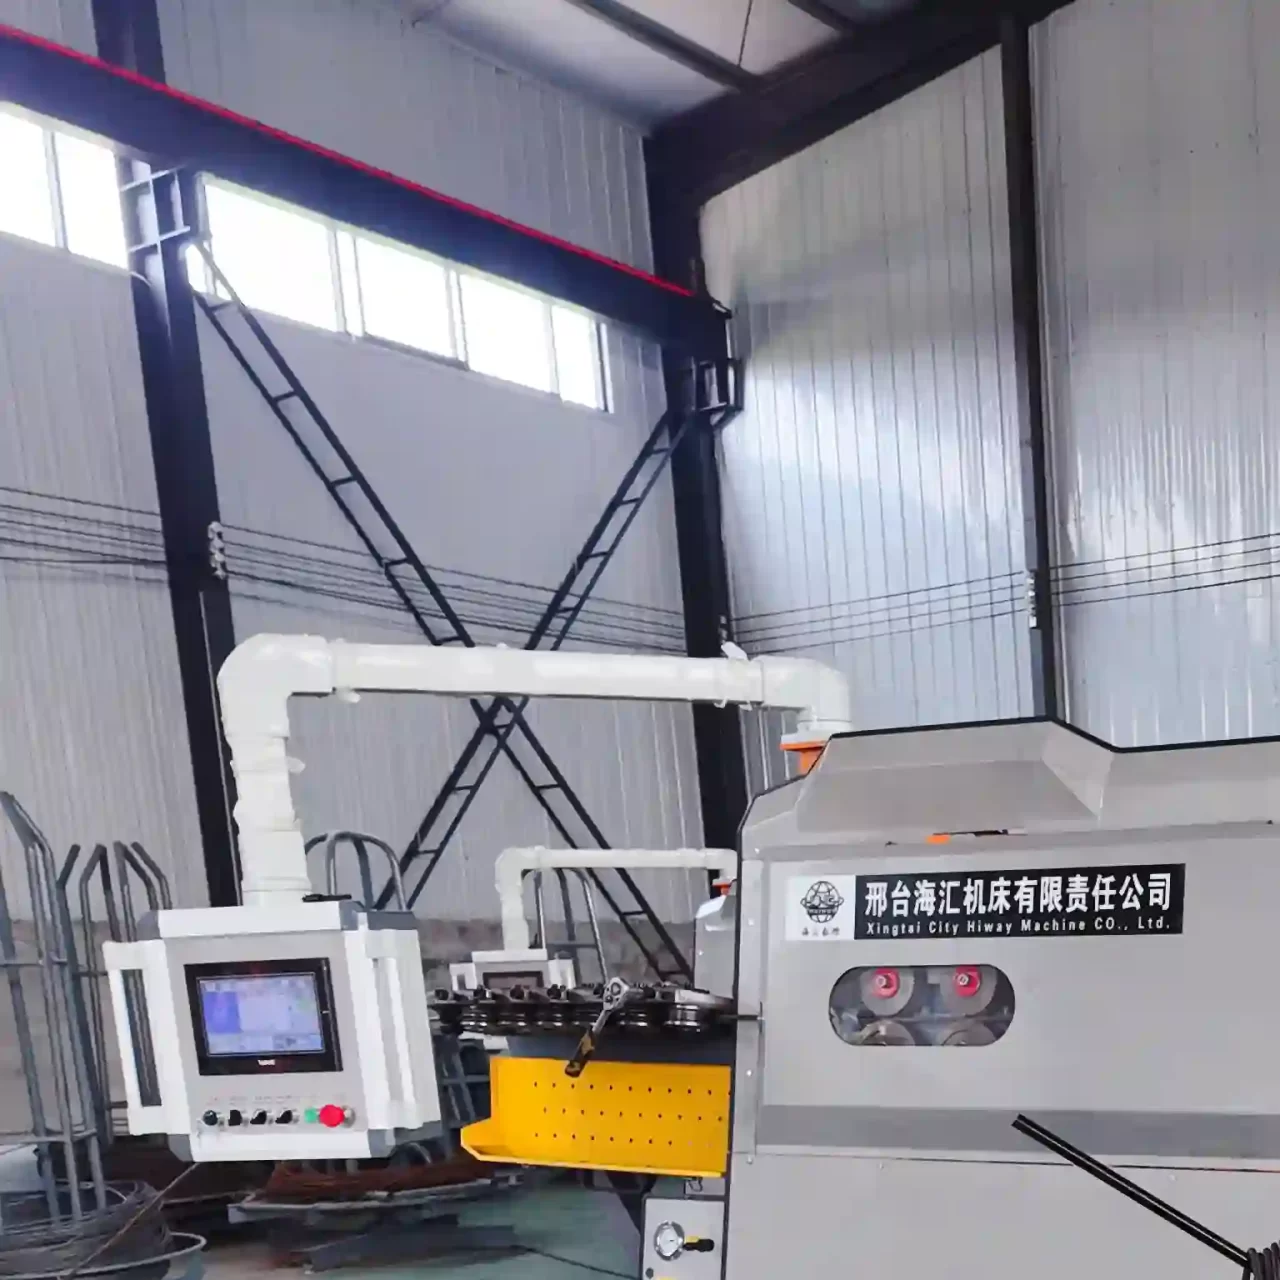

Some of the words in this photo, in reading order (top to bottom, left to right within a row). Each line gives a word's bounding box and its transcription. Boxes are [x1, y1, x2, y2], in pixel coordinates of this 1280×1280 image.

[864, 872, 1171, 918] 邢台海汇机床有限责任公司
[866, 921, 920, 937] Xingtai
[928, 921, 959, 936] City
[967, 920, 1012, 935] Hiway
[1021, 918, 1085, 932] Machine
[1138, 916, 1170, 930] Ltd.
